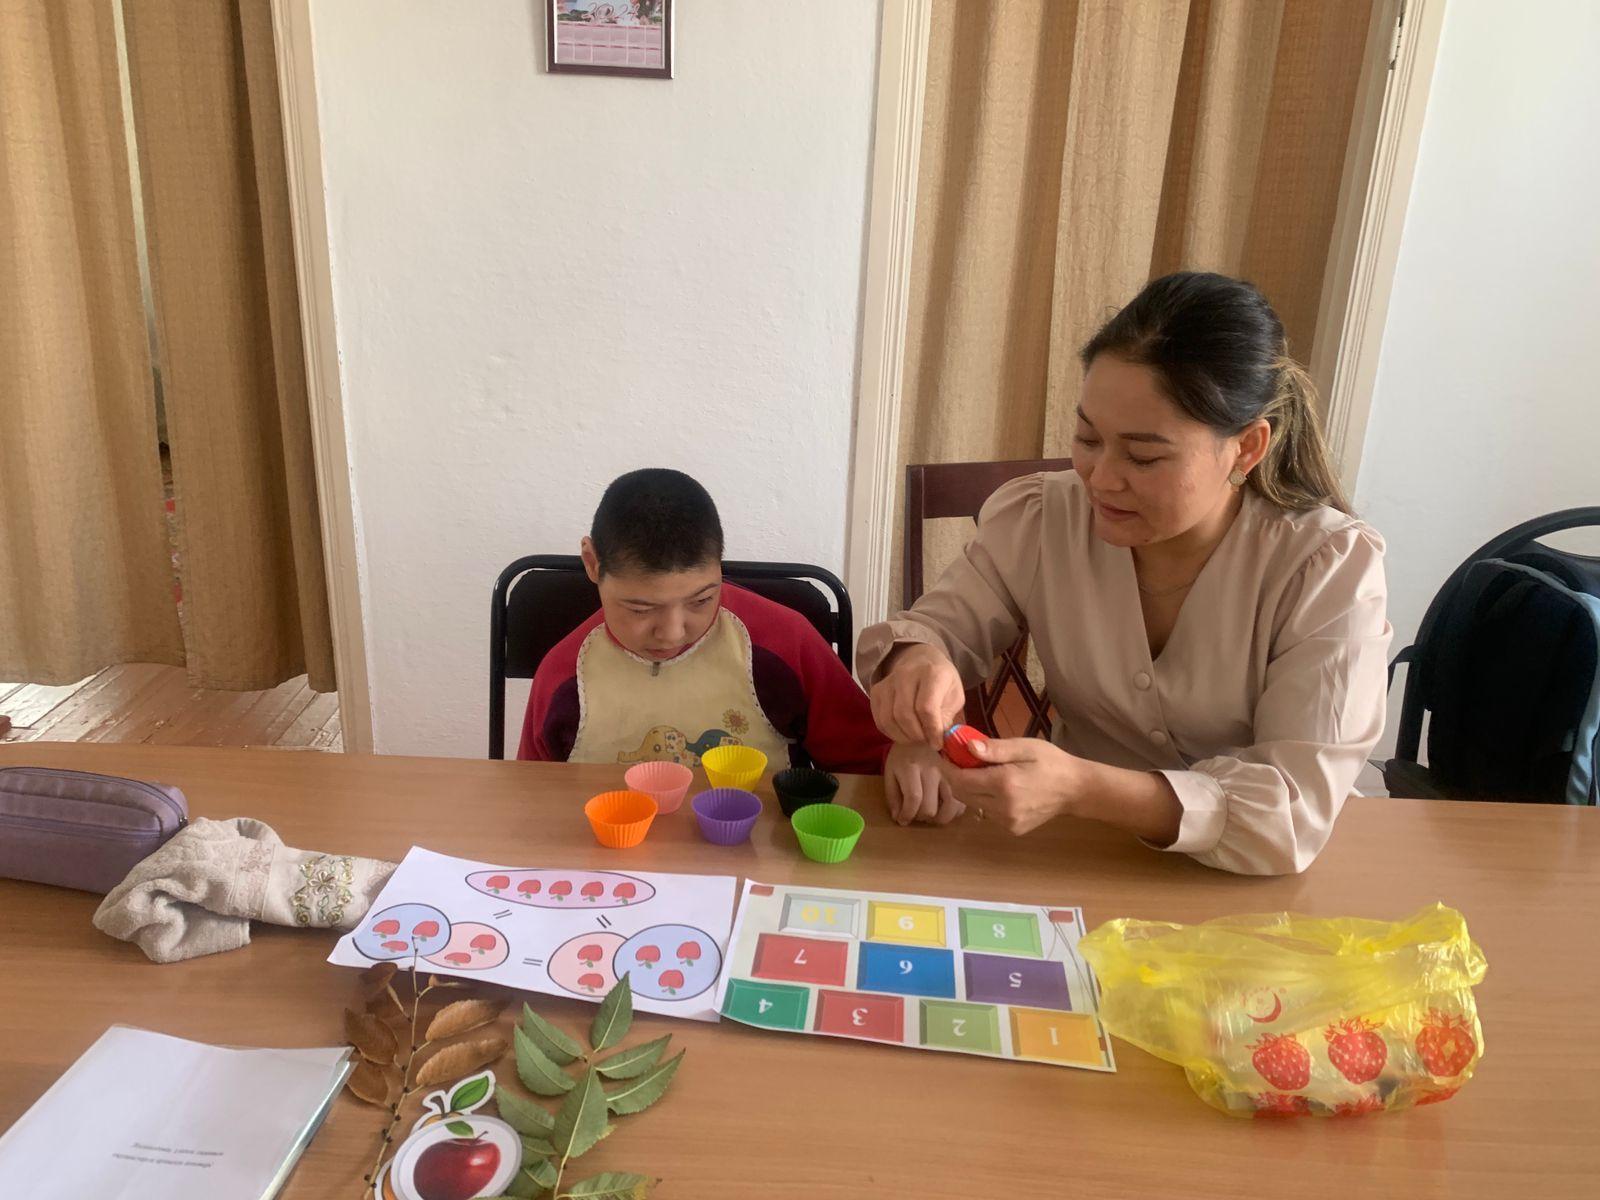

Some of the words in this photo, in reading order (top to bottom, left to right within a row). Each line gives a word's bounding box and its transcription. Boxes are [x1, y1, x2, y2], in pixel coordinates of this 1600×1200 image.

[801, 905, 838, 926] 10
[897, 916, 915, 931] 9
[992, 923, 1006, 939] 8
[793, 949, 808, 965] 7
[899, 959, 913, 975] 6
[1008, 972, 1023, 988] 5
[758, 998, 773, 1014] 4
[851, 1007, 868, 1026] 3
[952, 1018, 967, 1037] 2
[1049, 1027, 1059, 1046] 1
